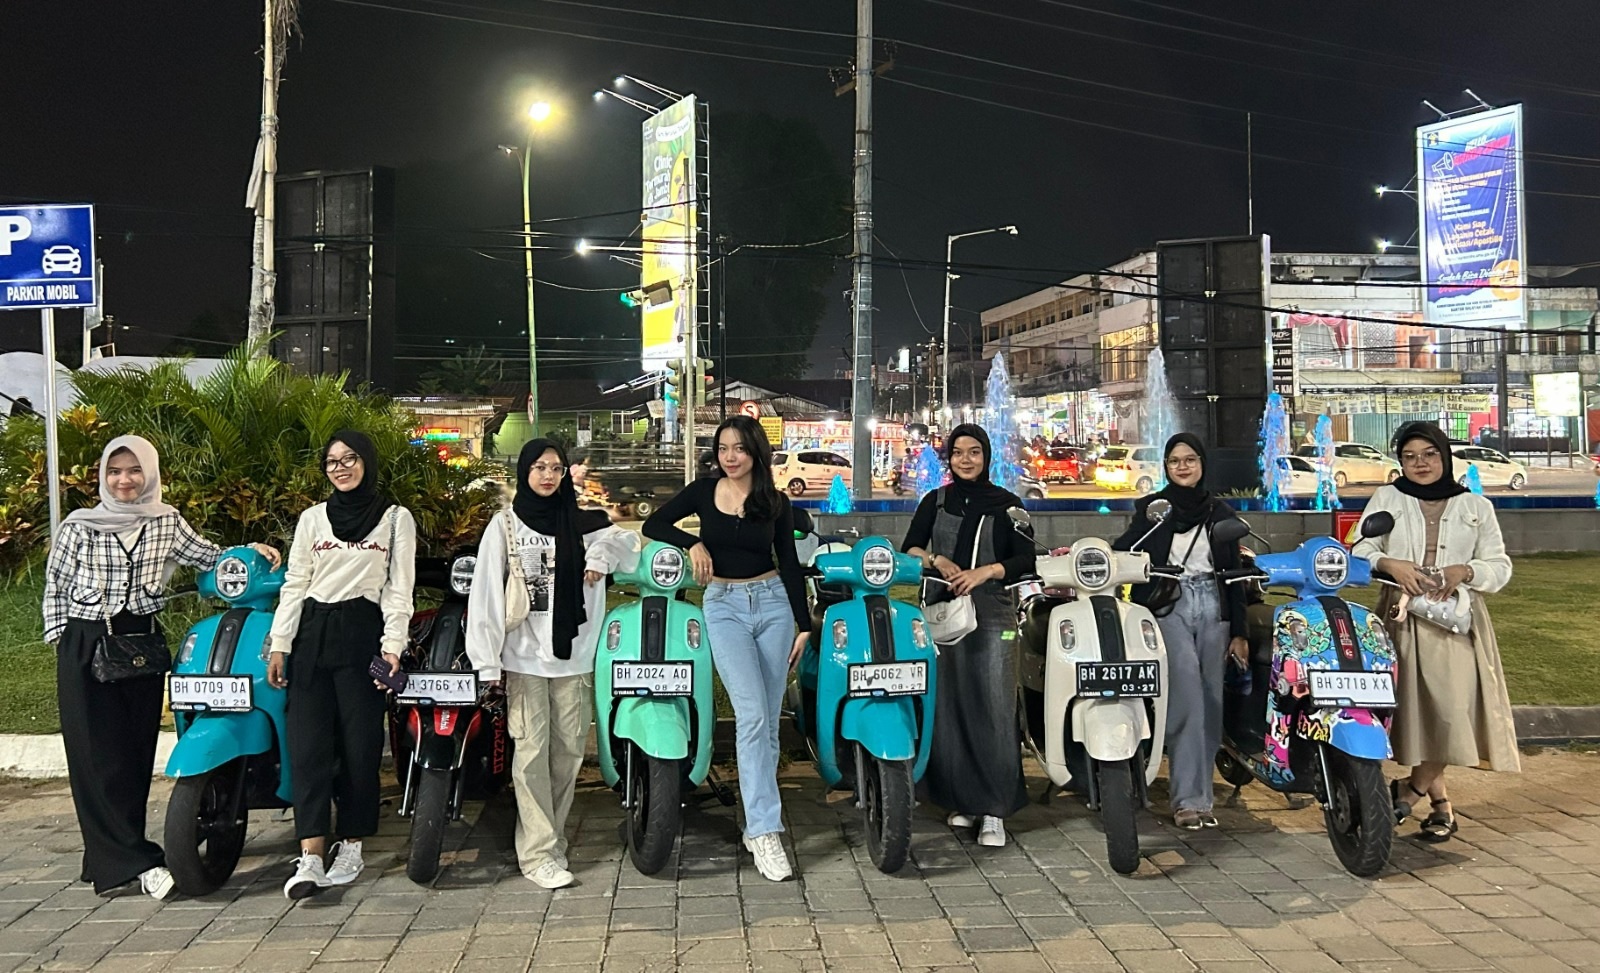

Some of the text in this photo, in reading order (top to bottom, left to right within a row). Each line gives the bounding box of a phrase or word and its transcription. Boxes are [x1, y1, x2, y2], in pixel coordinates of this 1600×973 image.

[0, 216, 32, 255] P
[7, 285, 79, 301] PARKIR MOBIL
[1282, 358, 1292, 366] KM
[1281, 384, 1292, 394] KM
[617, 668, 630, 679] BH
[637, 668, 664, 678] 2024
[853, 666, 923, 681] BH 6062 VR
[1081, 666, 1154, 680] BH 2617 AK
[174, 682, 188, 693] BH
[194, 682, 222, 693] 0709
[421, 680, 449, 690] 3766
[457, 680, 471, 689] XY
[1316, 676, 1389, 690] BH 3718 XX
